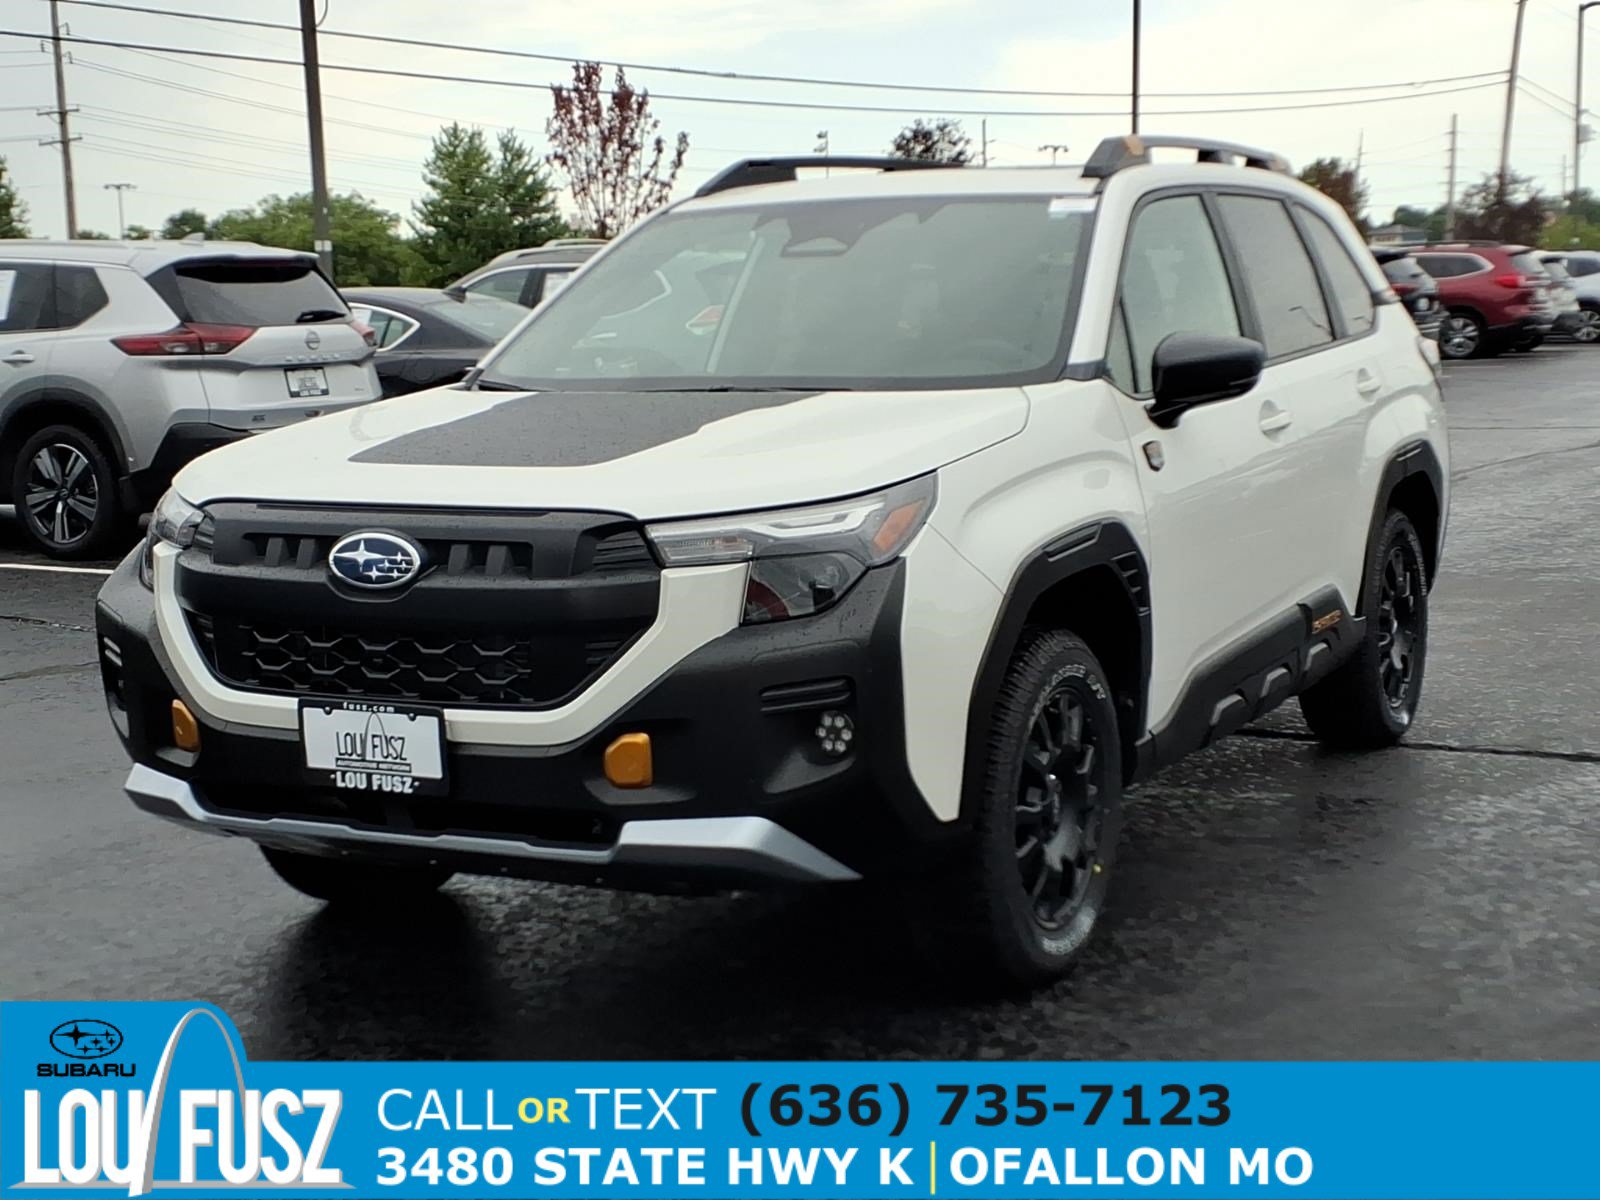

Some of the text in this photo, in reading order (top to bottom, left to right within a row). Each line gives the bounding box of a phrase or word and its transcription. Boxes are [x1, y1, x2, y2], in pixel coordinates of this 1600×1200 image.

[336, 731, 407, 761] LOU FUSZ
[336, 771, 413, 794] LOU FUSZ
